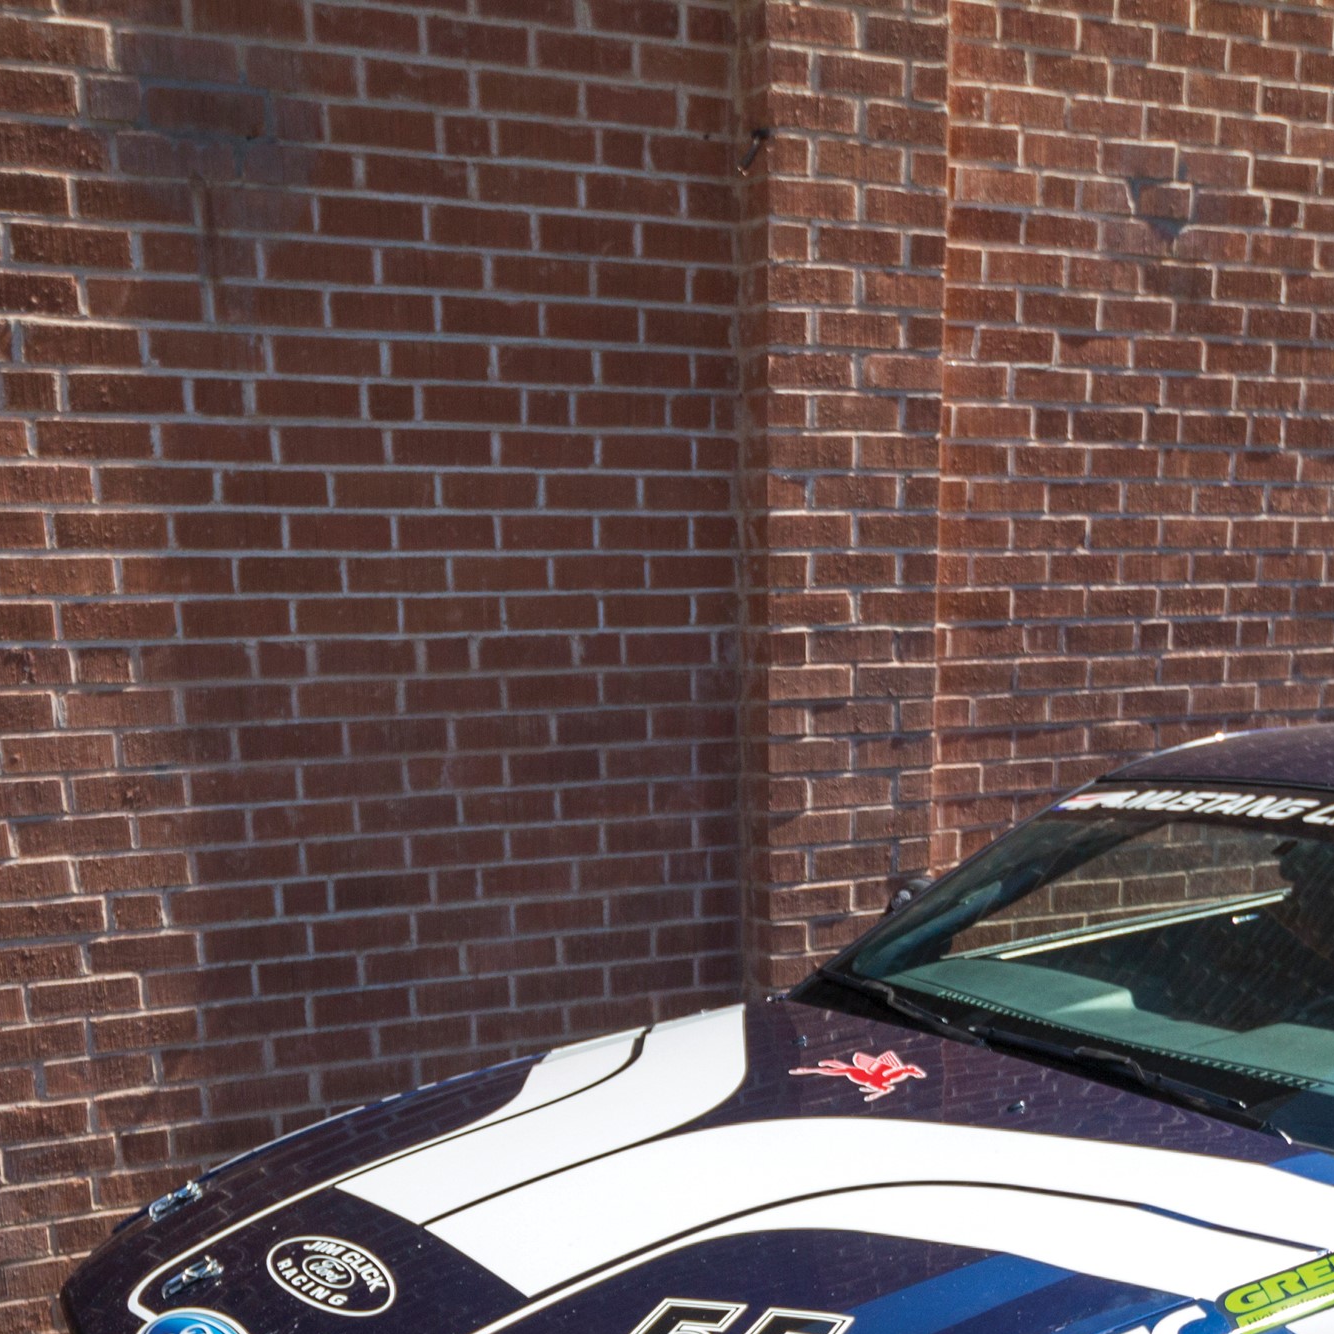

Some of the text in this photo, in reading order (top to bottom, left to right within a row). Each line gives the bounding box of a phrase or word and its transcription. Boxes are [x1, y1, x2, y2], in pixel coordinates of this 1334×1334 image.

[1119, 790, 1320, 820] MUSTANG
[276, 1257, 348, 1307] RACING
[303, 1240, 386, 1293] JIM CLICK
[309, 1258, 349, 1285] Ford
